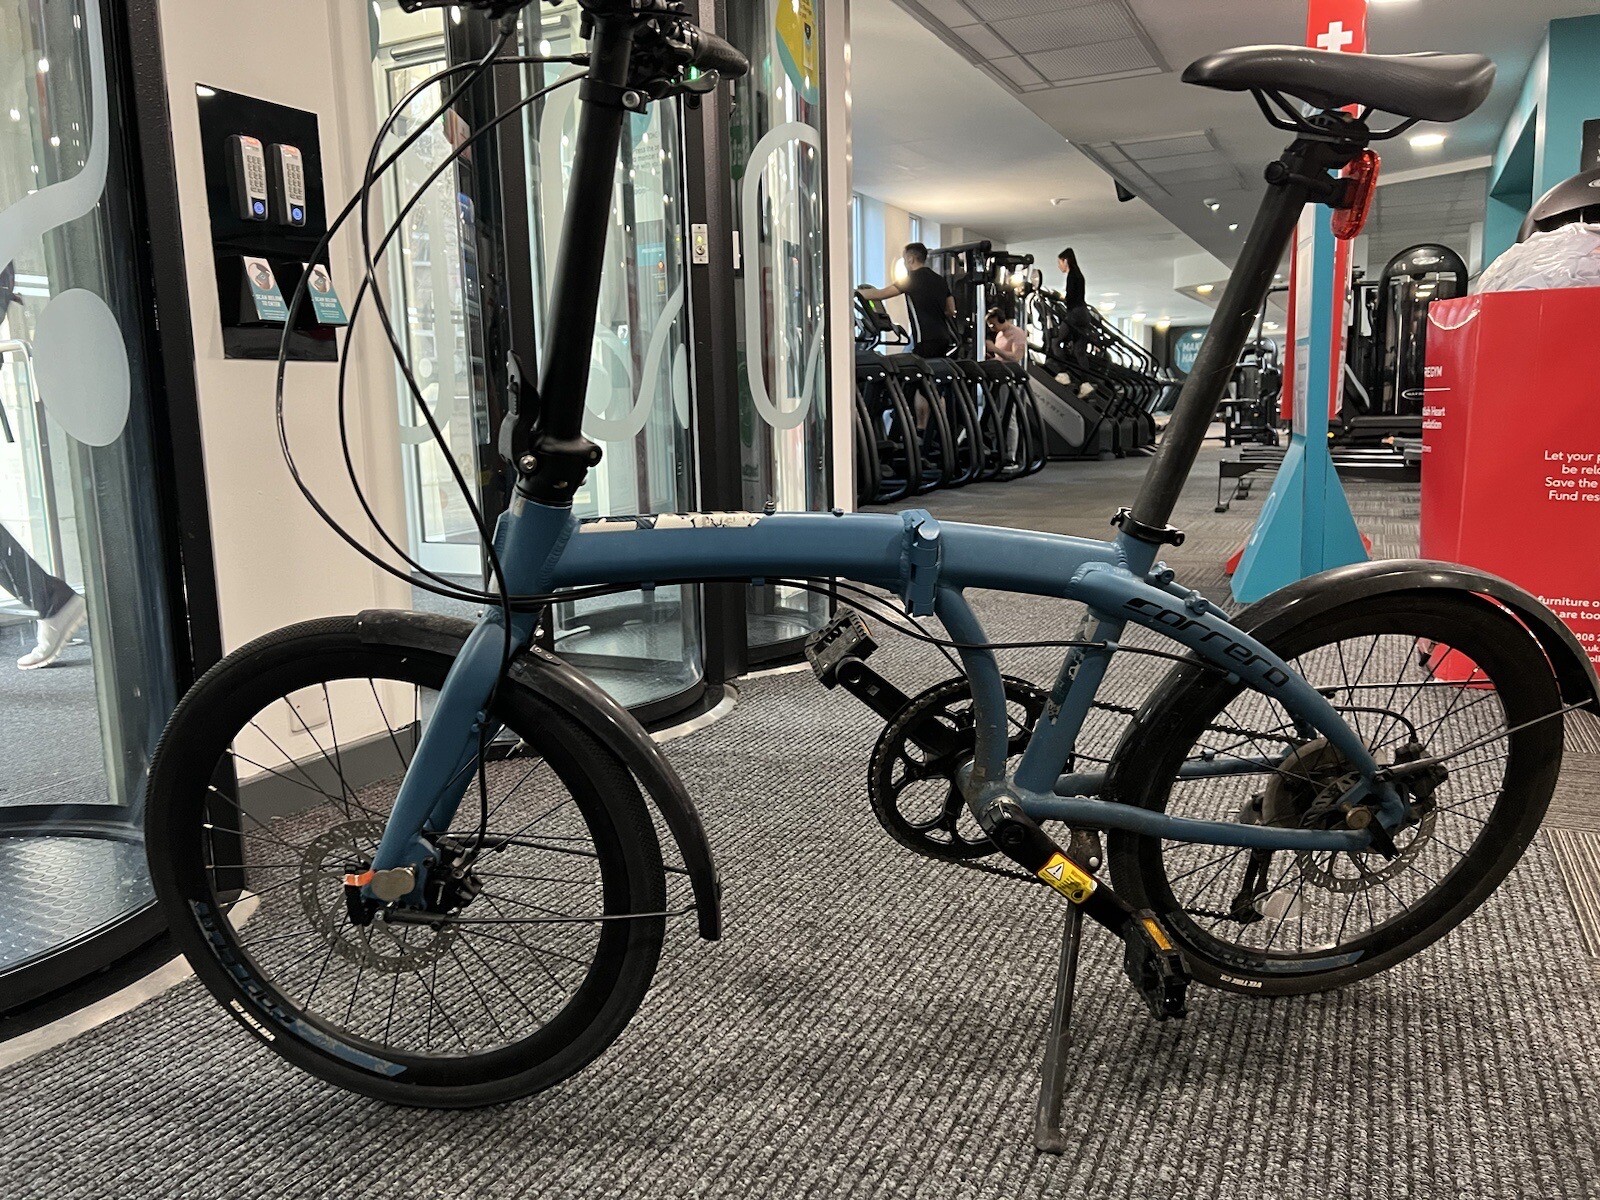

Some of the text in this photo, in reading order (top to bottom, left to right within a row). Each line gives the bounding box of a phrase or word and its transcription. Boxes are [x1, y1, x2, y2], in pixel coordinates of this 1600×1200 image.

[1544, 449, 1564, 461] Let
[1566, 453, 1594, 464] your
[1561, 463, 1578, 474] be
[1544, 476, 1598, 488] Save the
[1548, 489, 1579, 501] Fund
[1559, 611, 1577, 619] are
